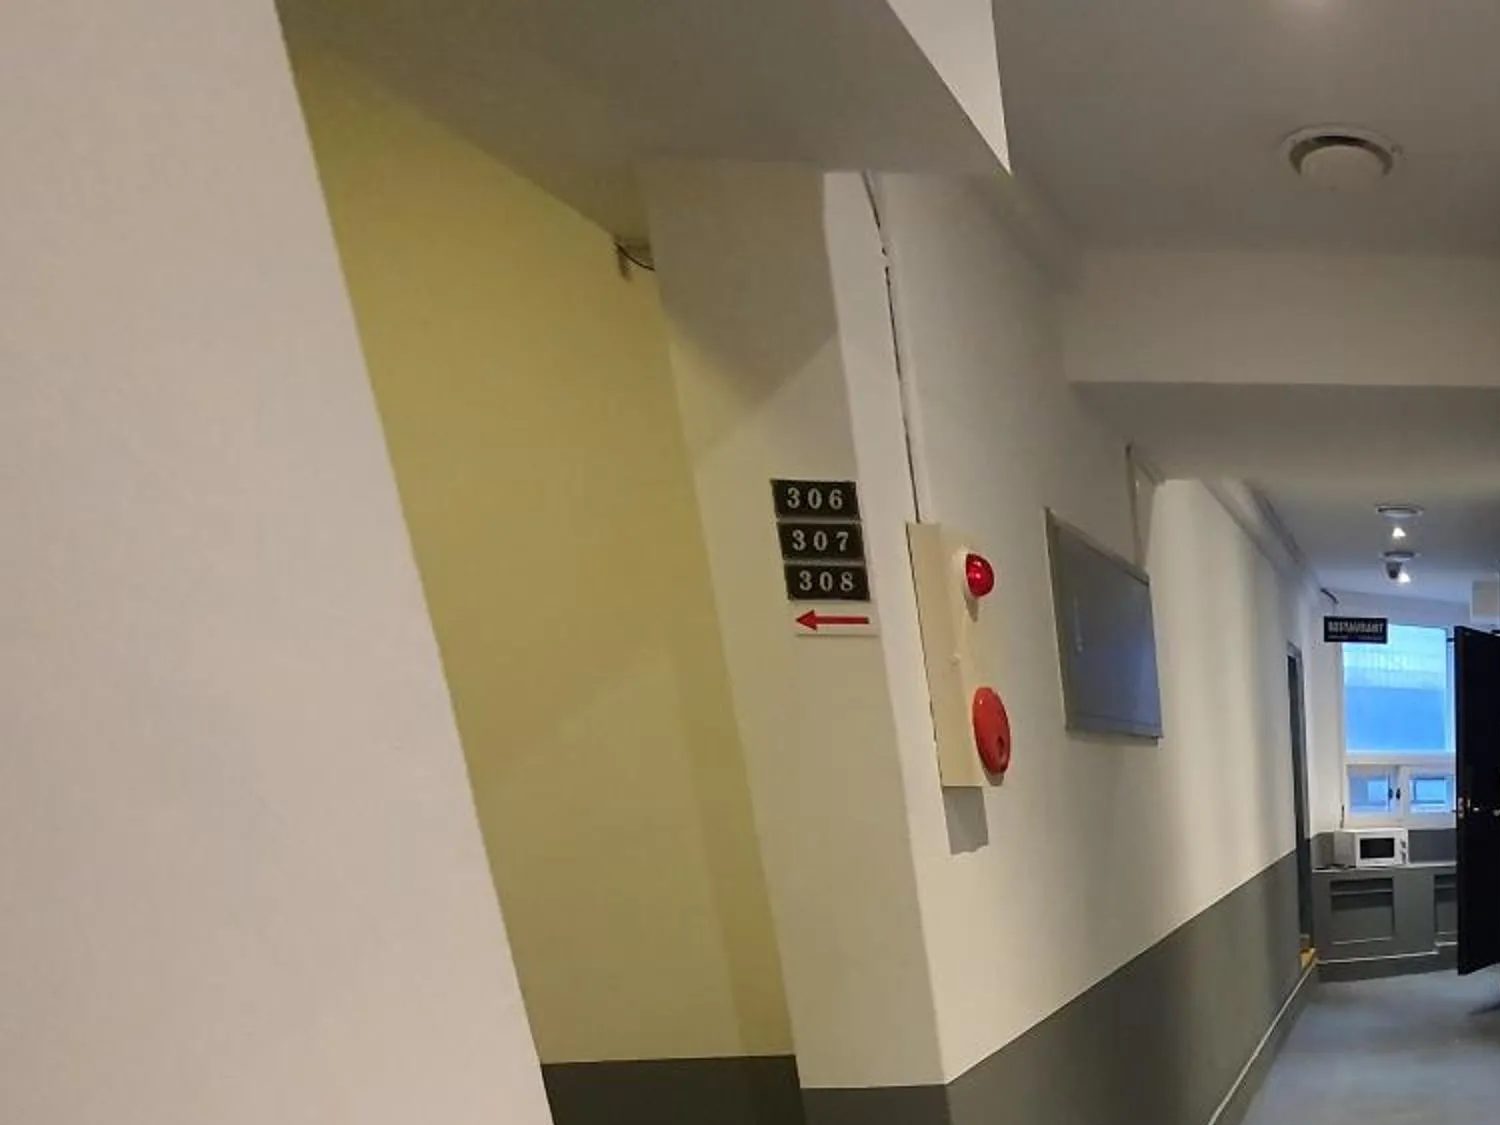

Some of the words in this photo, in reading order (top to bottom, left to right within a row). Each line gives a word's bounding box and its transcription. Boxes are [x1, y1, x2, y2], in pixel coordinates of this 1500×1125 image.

[787, 487, 843, 509] 306
[792, 530, 849, 551] 307
[799, 570, 853, 591] 308
